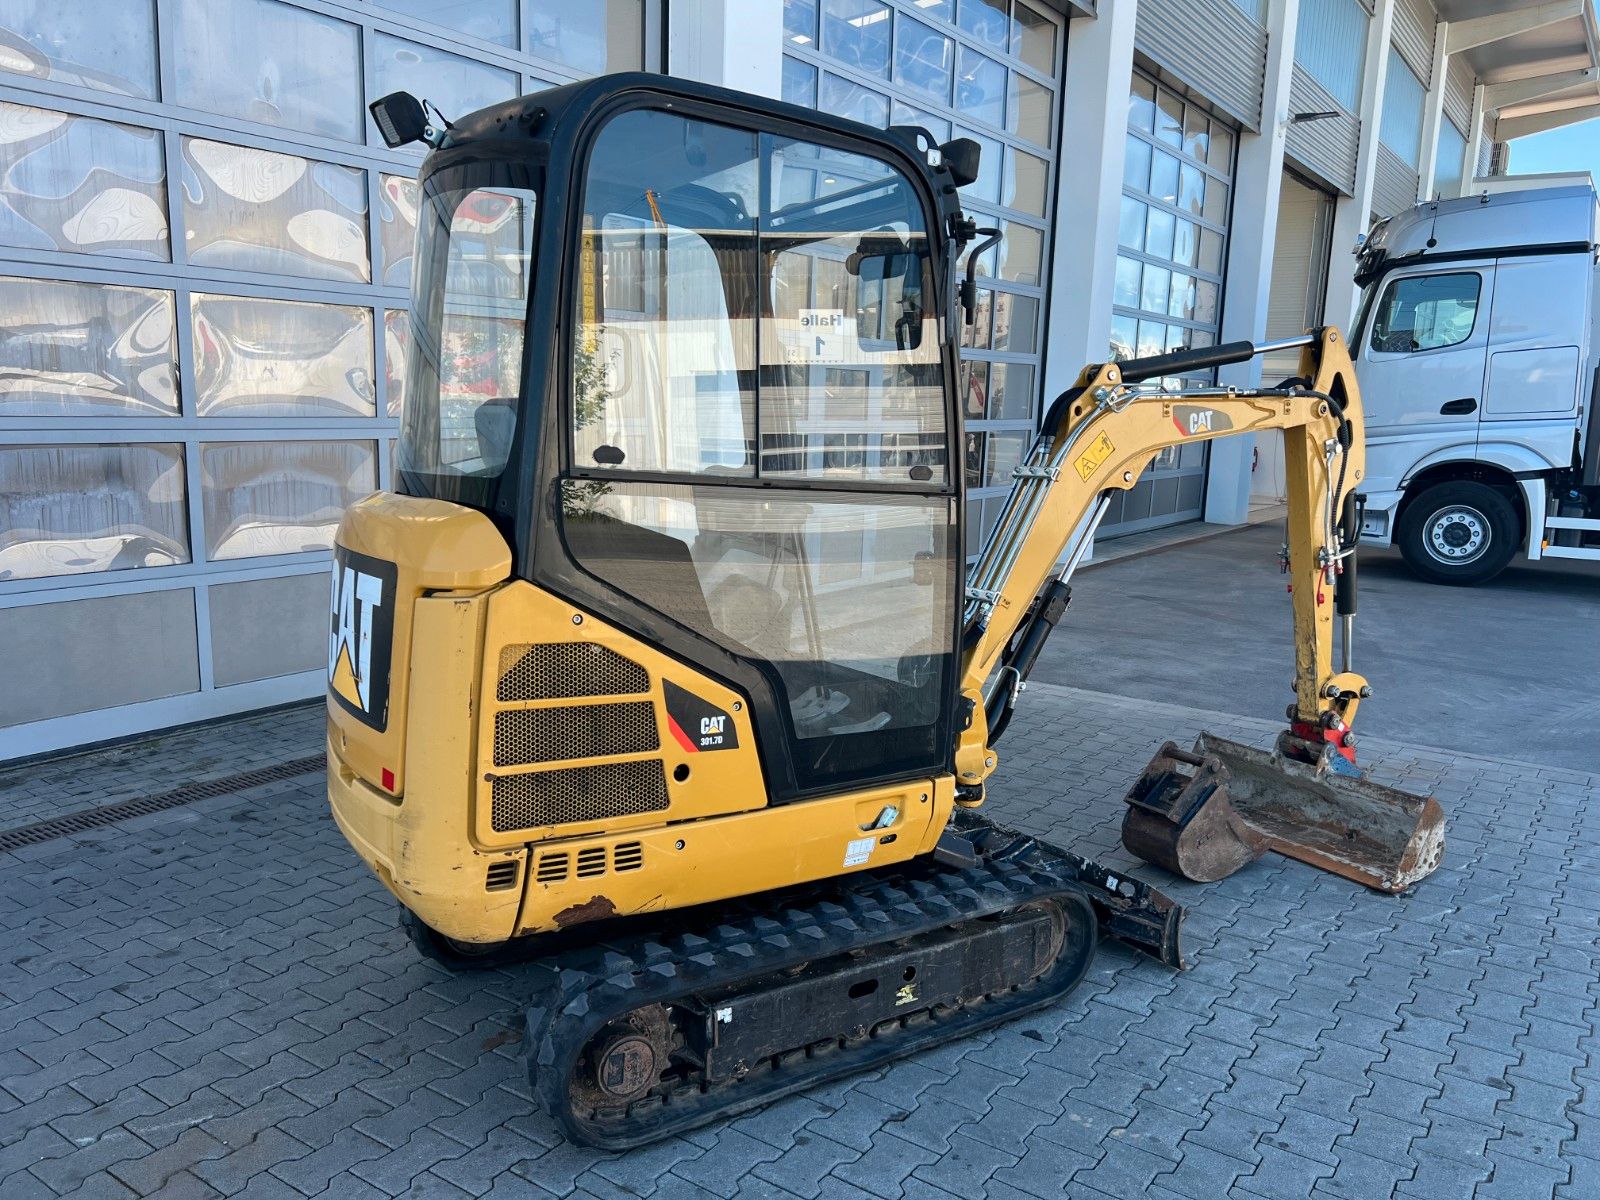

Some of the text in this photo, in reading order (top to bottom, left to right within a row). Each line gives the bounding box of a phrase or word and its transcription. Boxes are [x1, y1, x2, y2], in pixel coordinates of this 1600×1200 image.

[1189, 410, 1213, 434] CAT
[328, 558, 383, 714] CAT
[700, 715, 726, 735] CAT
[700, 735, 723, 747] 301.7D
